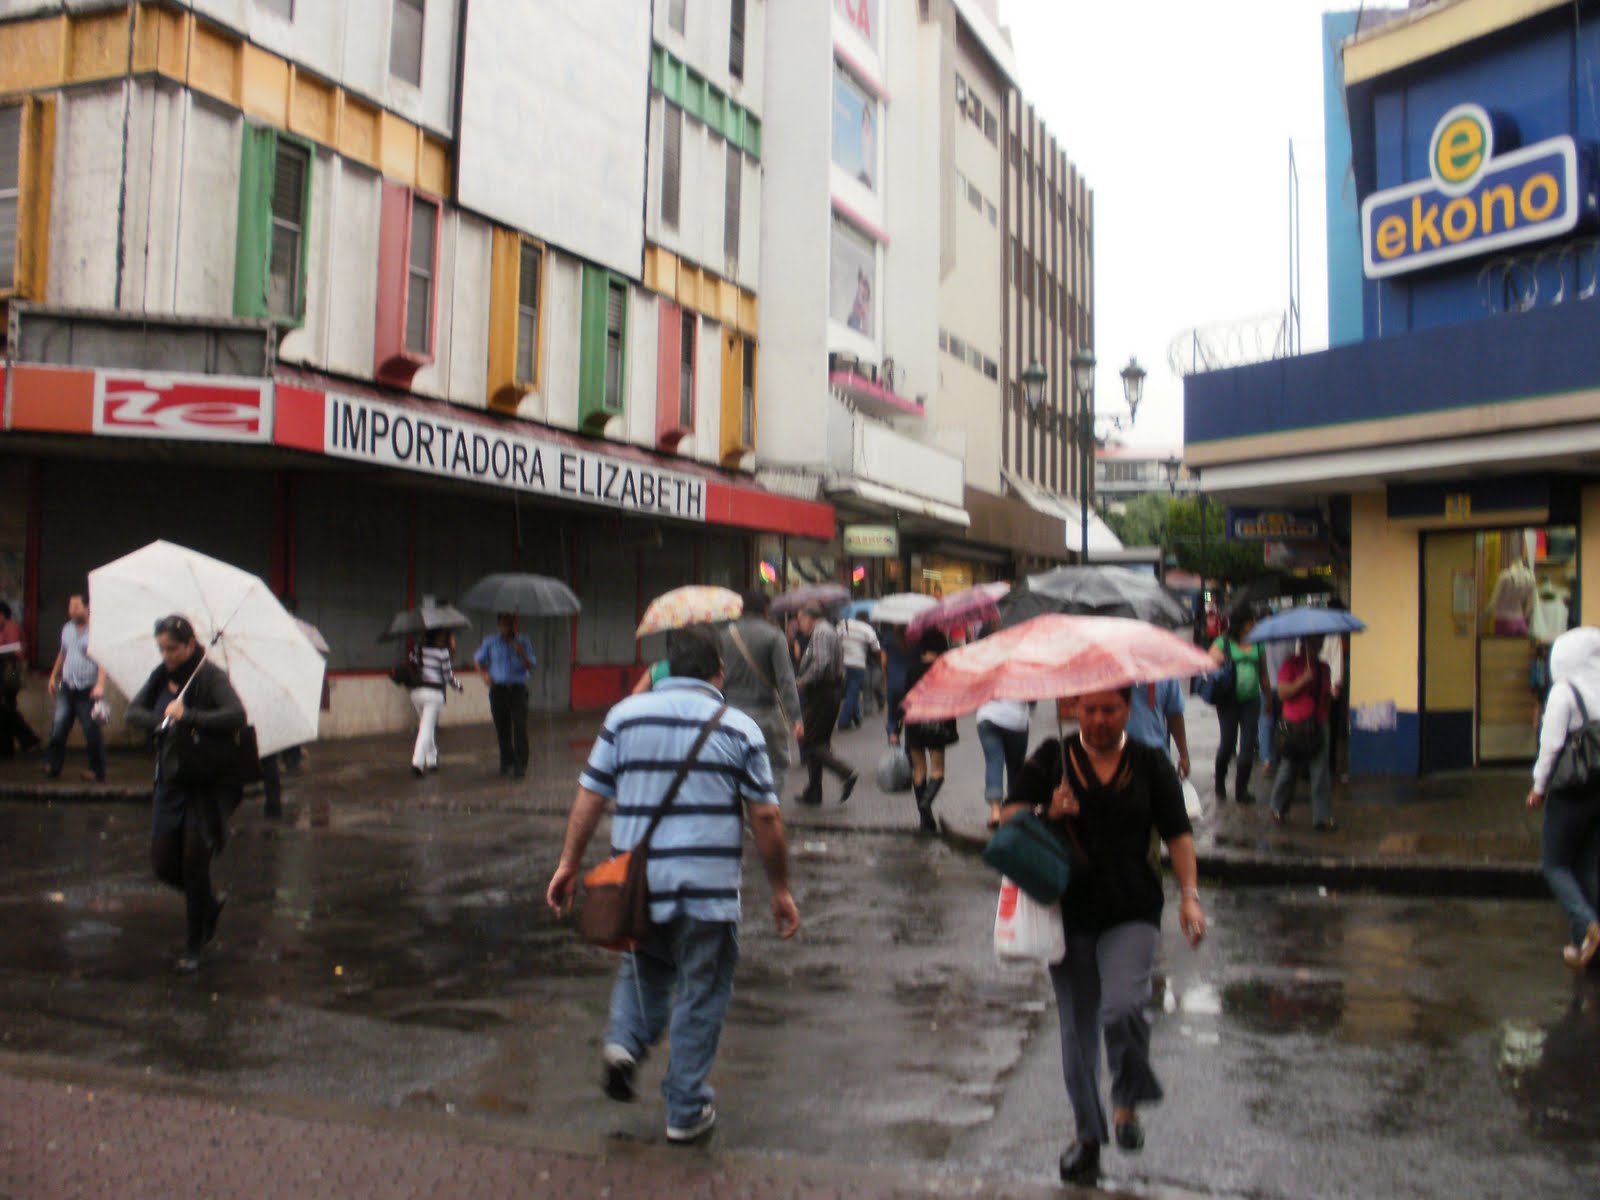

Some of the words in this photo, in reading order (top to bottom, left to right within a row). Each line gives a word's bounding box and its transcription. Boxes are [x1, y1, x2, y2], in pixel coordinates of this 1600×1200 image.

[1438, 117, 1483, 183] e
[1376, 172, 1559, 260] ekono
[332, 399, 546, 488] IMPORTADORA
[559, 452, 702, 515] ELIZABETH
